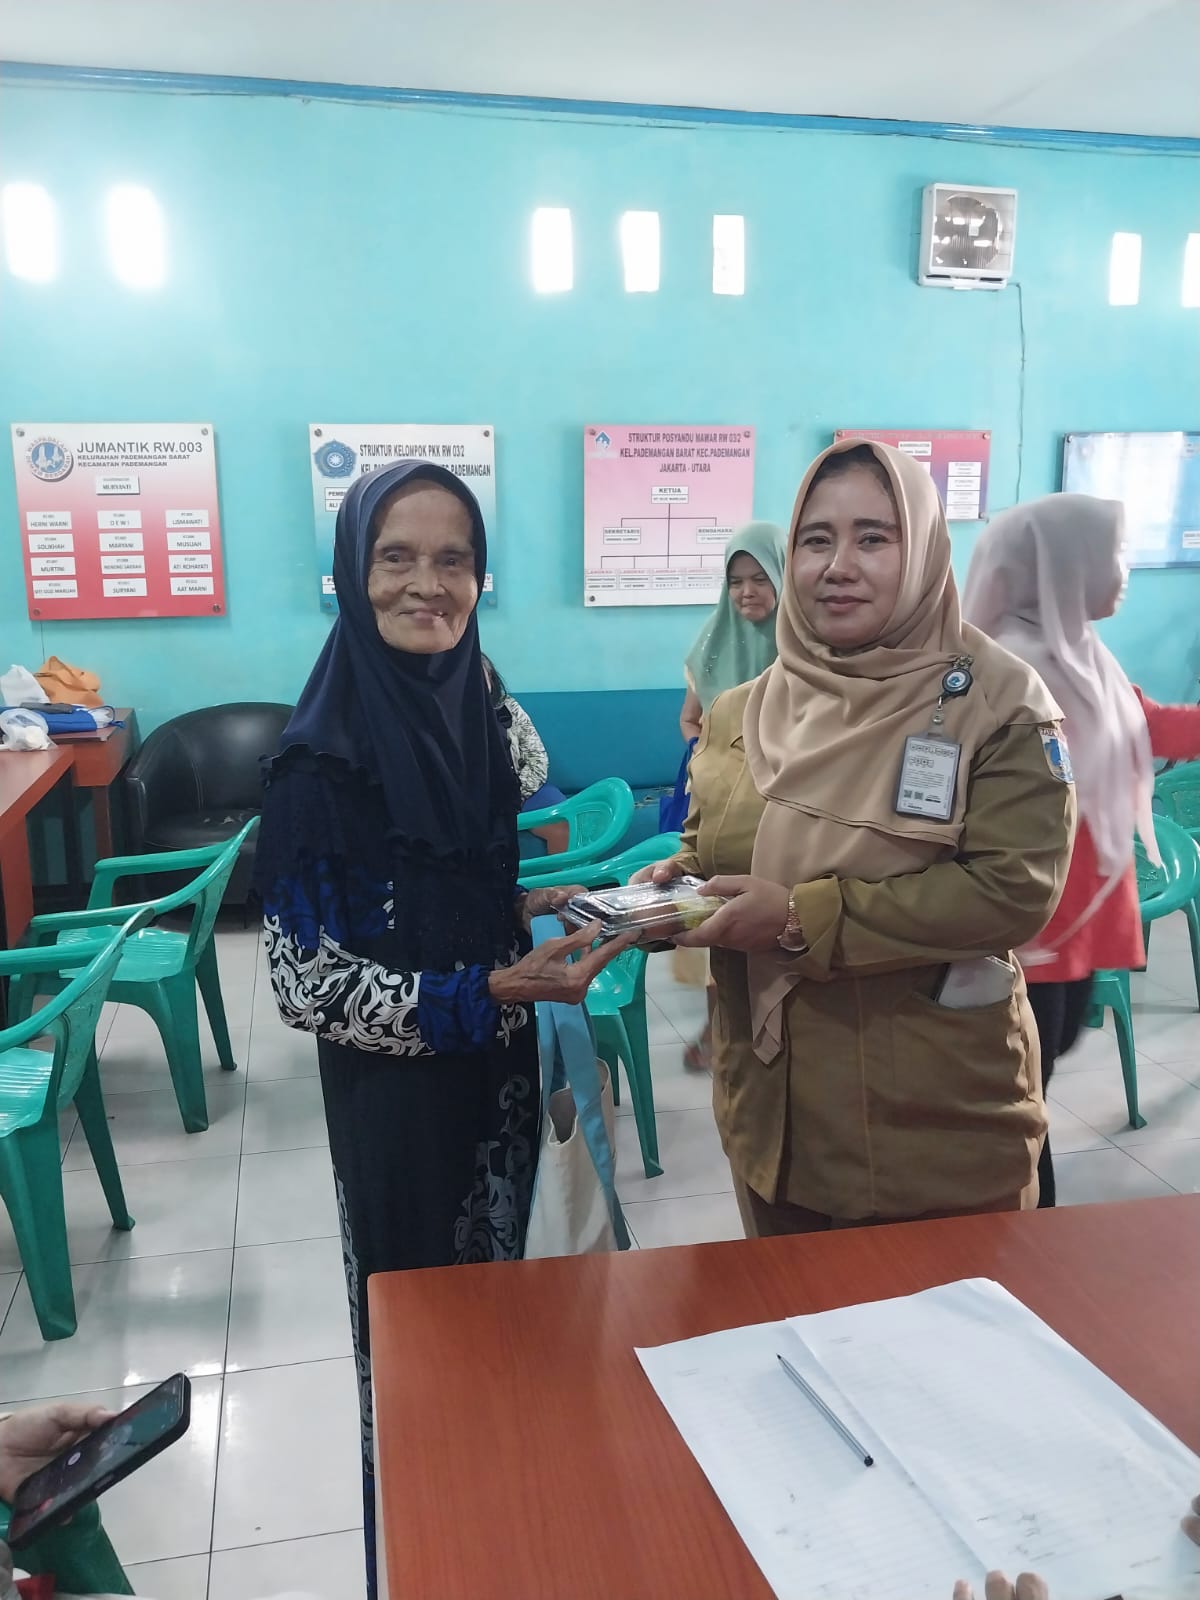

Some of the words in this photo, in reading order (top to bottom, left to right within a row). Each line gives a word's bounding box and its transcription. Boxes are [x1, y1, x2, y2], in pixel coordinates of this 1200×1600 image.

[628, 432, 660, 443] STRUKTUR
[662, 432, 693, 443] POSYANDU
[696, 432, 717, 443] MAWAR
[719, 433, 728, 443] RW
[77, 442, 149, 453] JUMANTIK
[153, 442, 203, 453] RW.003
[360, 444, 393, 457] STRUKTUR
[394, 444, 427, 457] KELOMPOK
[428, 444, 441, 457] PKK
[442, 444, 451, 457] RW
[453, 444, 465, 457] 032
[620, 448, 674, 458] KEL.PADEMANGAN
[676, 448, 695, 458] BARAT
[697, 448, 750, 458] KEC.PADEMANGAN
[660, 463, 686, 473] JAKARTA
[692, 463, 711, 473] UTARA
